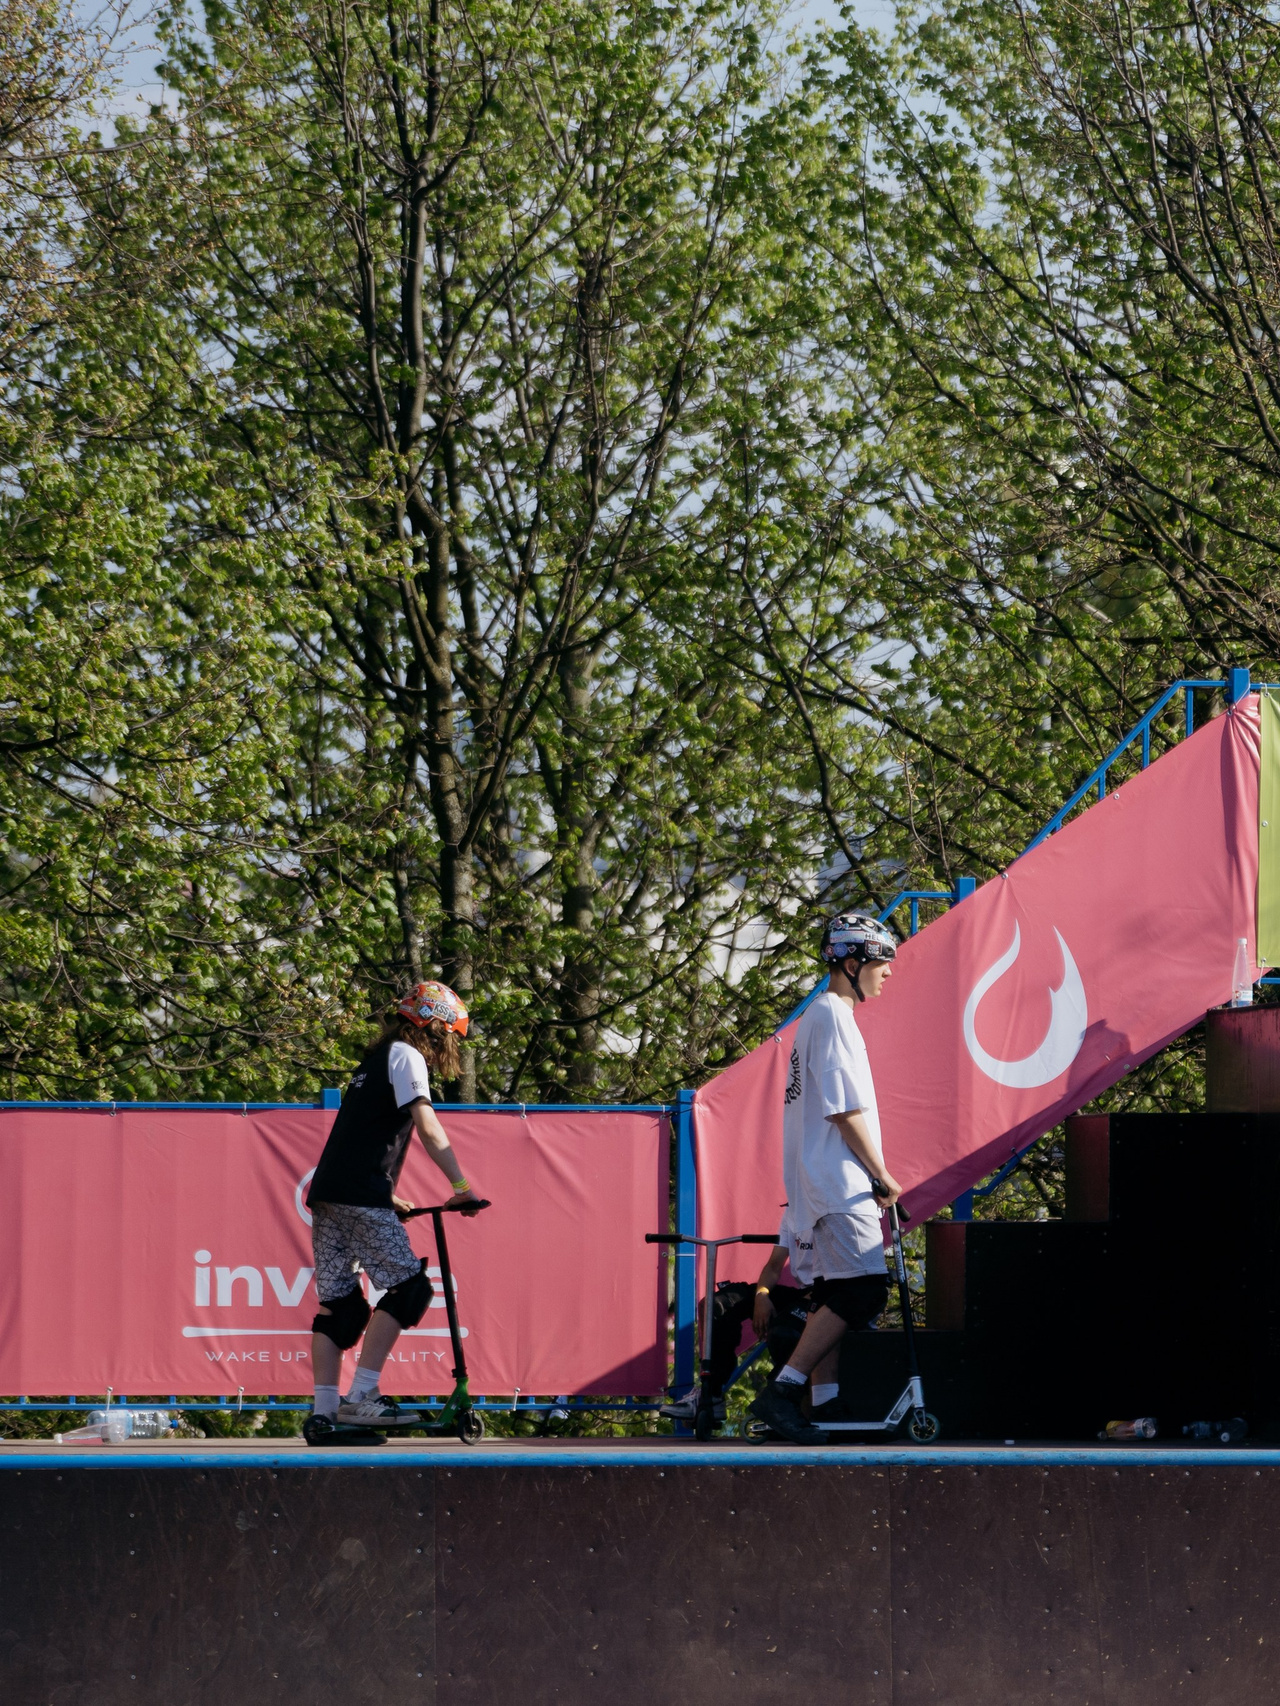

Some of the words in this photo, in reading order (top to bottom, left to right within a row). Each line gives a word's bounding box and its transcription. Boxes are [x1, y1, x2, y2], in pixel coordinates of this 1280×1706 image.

[434, 1002, 449, 1015] KSS
[194, 1250, 458, 1308] inve
[205, 1351, 270, 1362] WAKE
[279, 1351, 308, 1362] UP
